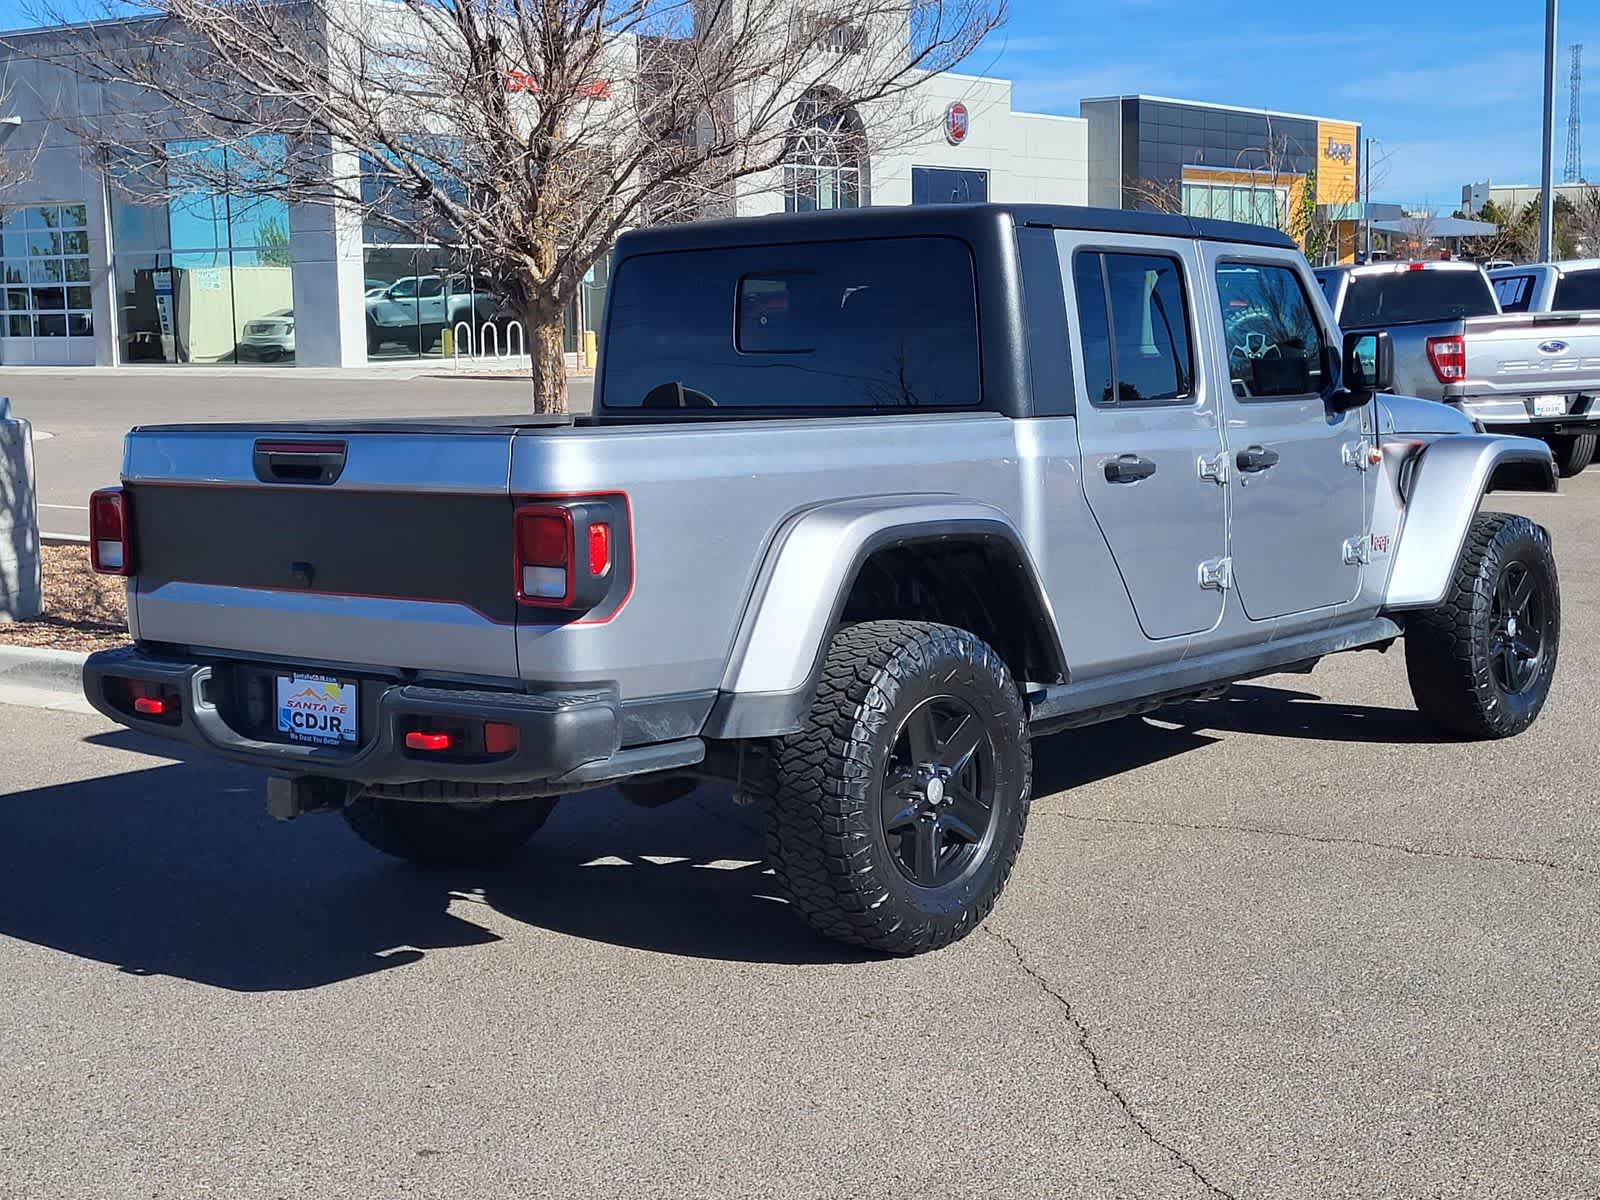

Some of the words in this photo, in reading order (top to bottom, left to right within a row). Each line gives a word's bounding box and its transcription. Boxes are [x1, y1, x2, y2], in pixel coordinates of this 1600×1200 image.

[1324, 136, 1352, 165] Jeep
[287, 700, 327, 712] SANTA
[331, 705, 348, 714] FE
[292, 711, 342, 733] CDJR
